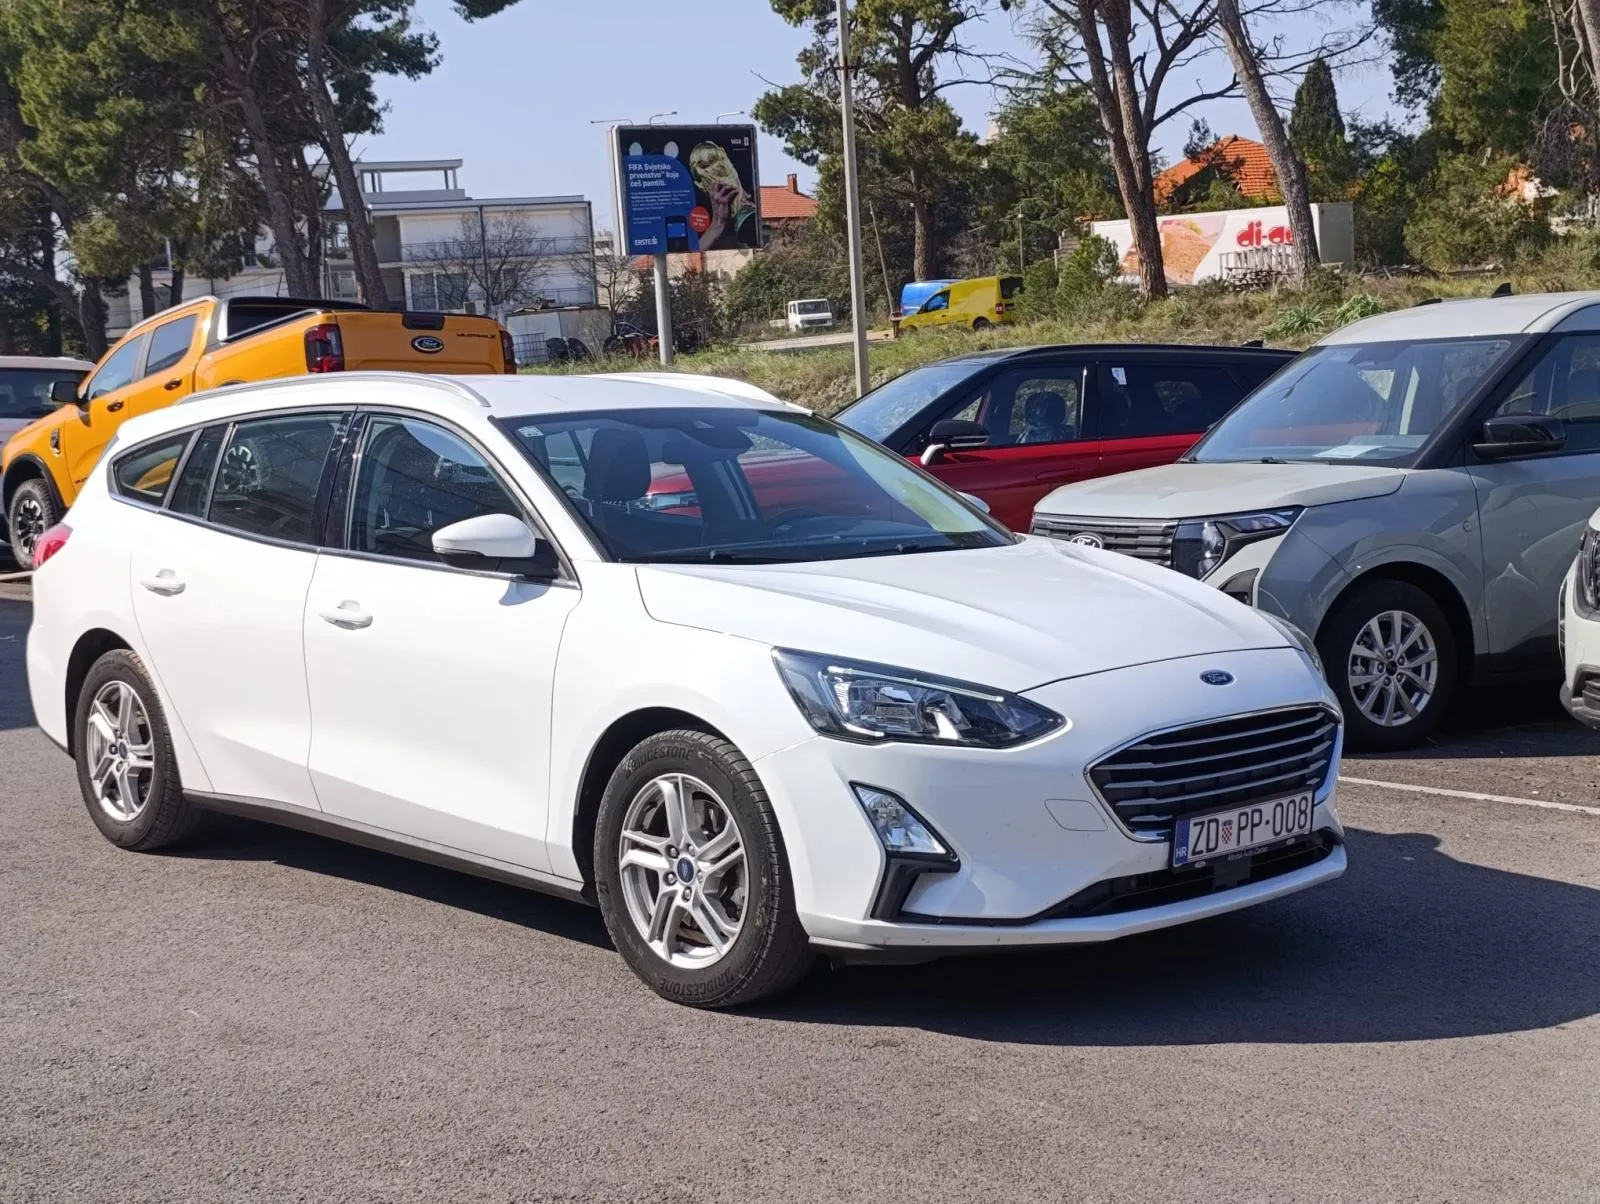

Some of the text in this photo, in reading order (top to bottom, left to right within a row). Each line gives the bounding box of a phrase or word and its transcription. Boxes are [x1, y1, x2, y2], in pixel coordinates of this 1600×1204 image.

[628, 163, 672, 172] FIFA Svjetsko
[665, 170, 680, 180] koje
[634, 238, 652, 247] ERSTE
[1175, 845, 1187, 859] HR
[1191, 817, 1220, 857] ZD
